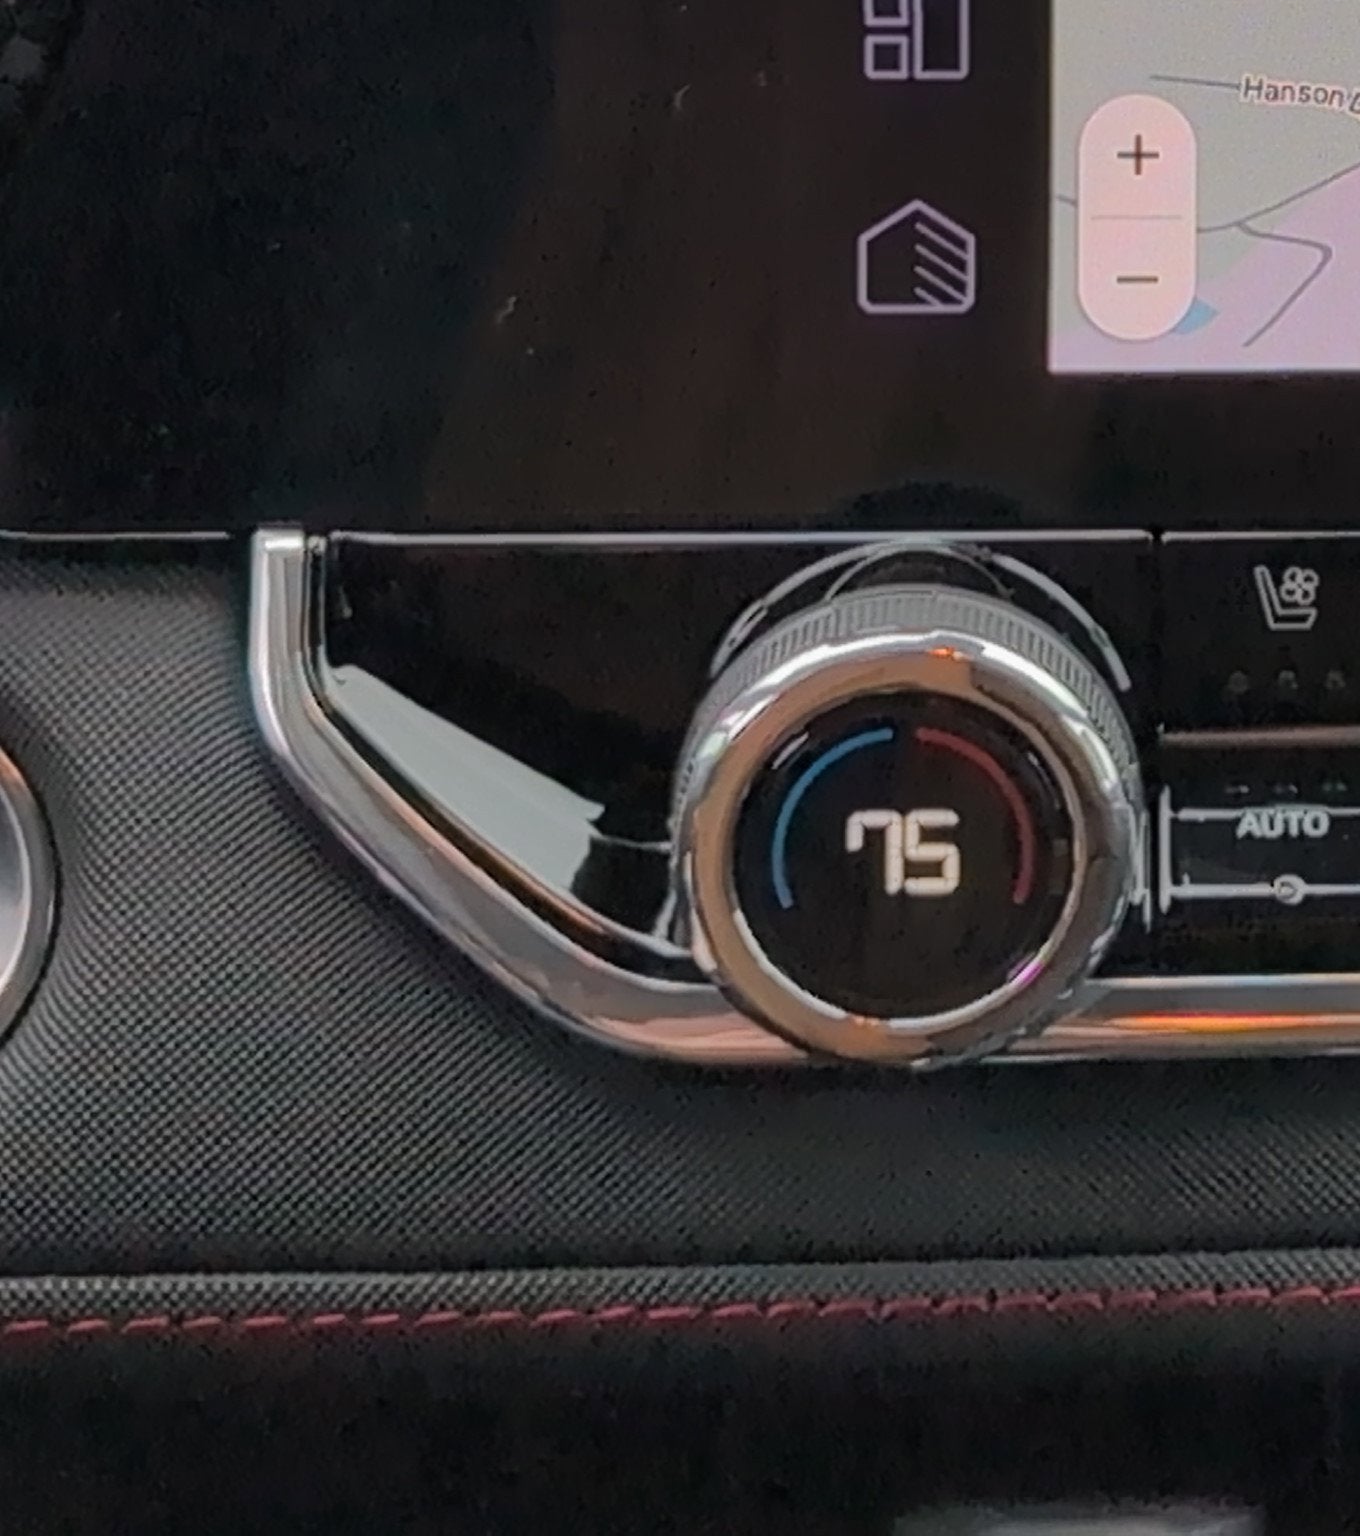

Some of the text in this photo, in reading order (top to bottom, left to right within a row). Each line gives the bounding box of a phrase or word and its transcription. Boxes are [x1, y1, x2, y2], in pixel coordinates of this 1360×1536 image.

[1243, 75, 1345, 108] Hanson
[1237, 809, 1331, 840] AUTO
[845, 808, 962, 897] 75
